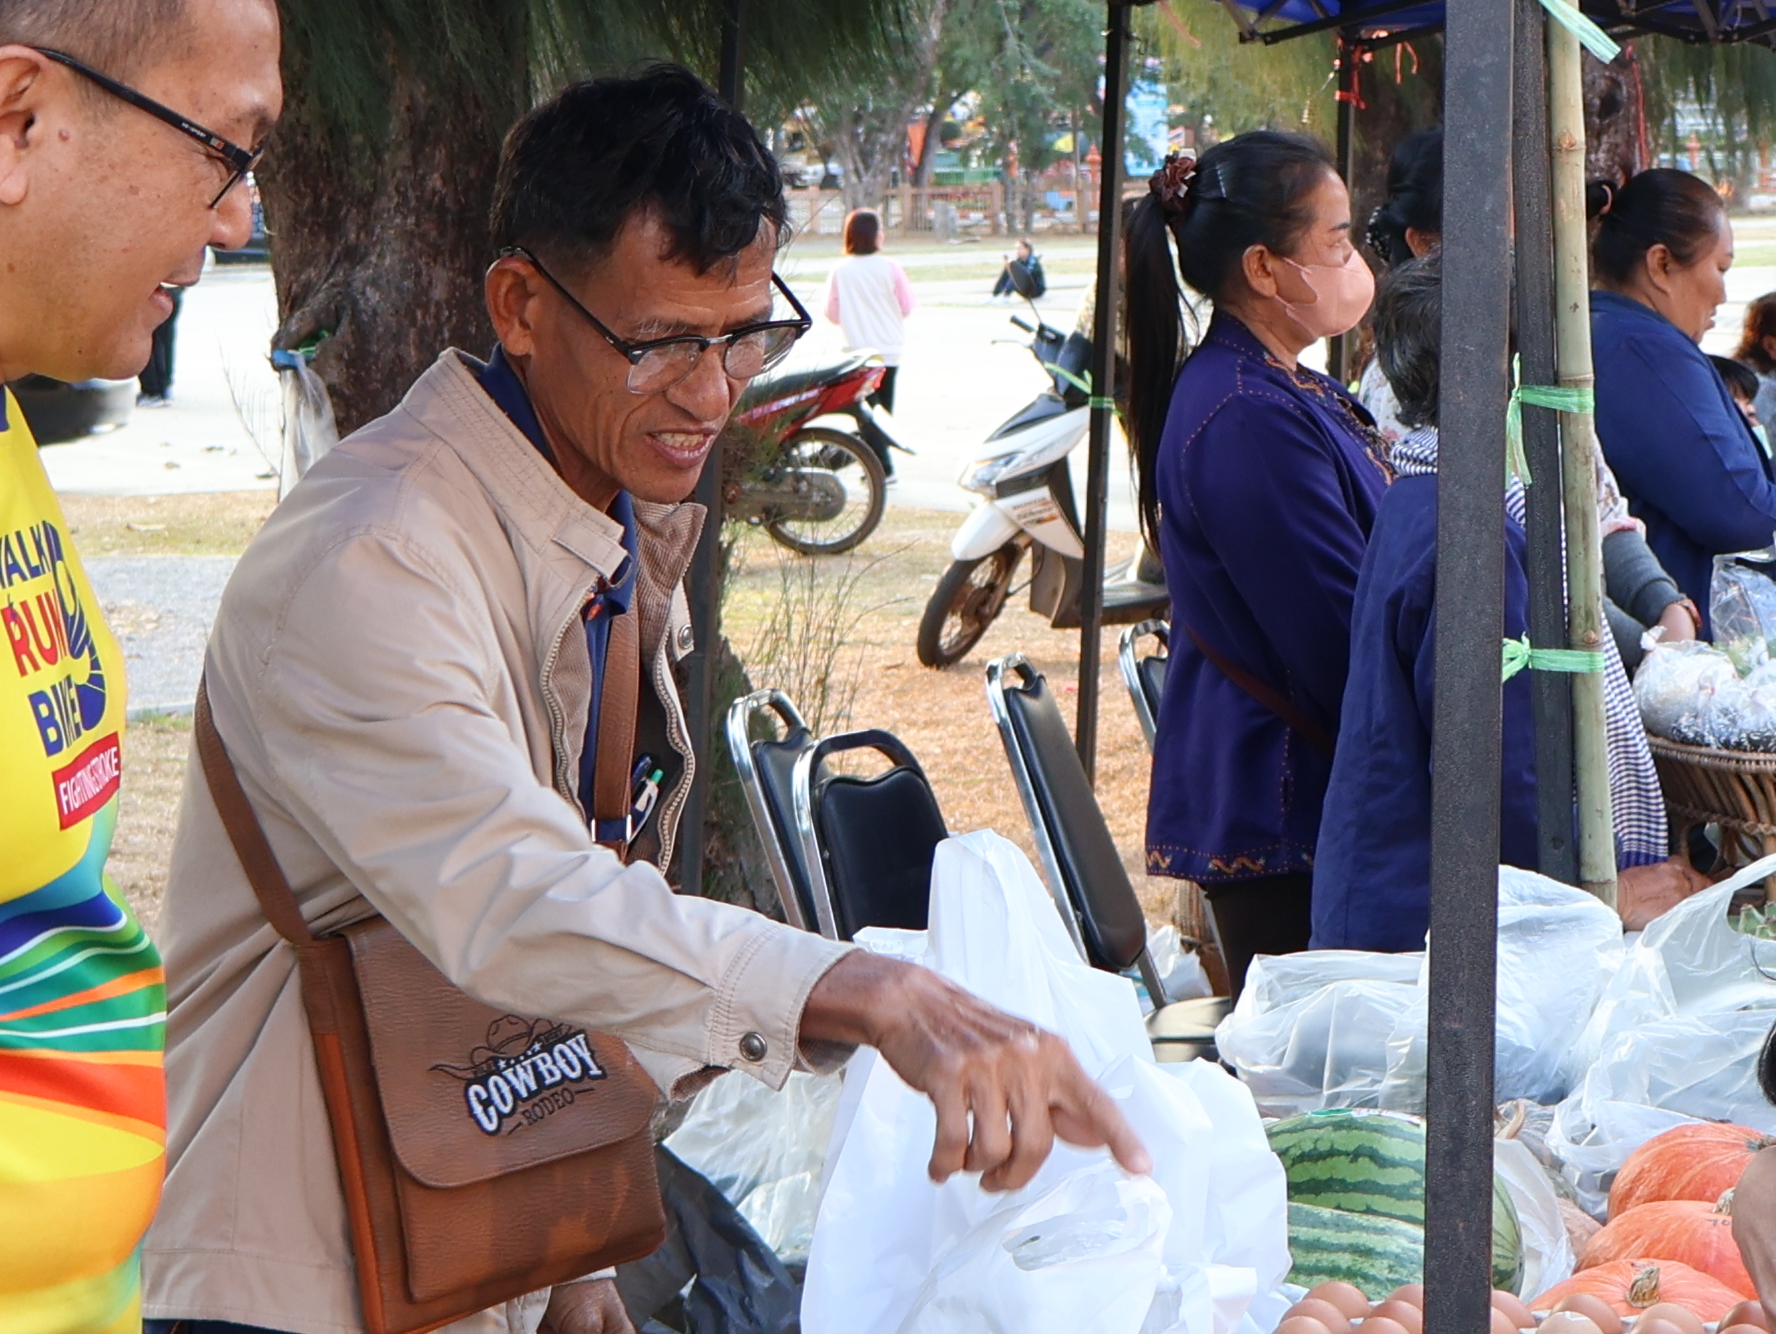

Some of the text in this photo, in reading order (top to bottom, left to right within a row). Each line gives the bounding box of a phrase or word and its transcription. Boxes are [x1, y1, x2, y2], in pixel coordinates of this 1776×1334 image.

[0, 589, 67, 678] RUN
[27, 674, 82, 758] BIKE
[467, 1033, 603, 1133] COWBOY
[521, 1088, 575, 1127] RODEO
